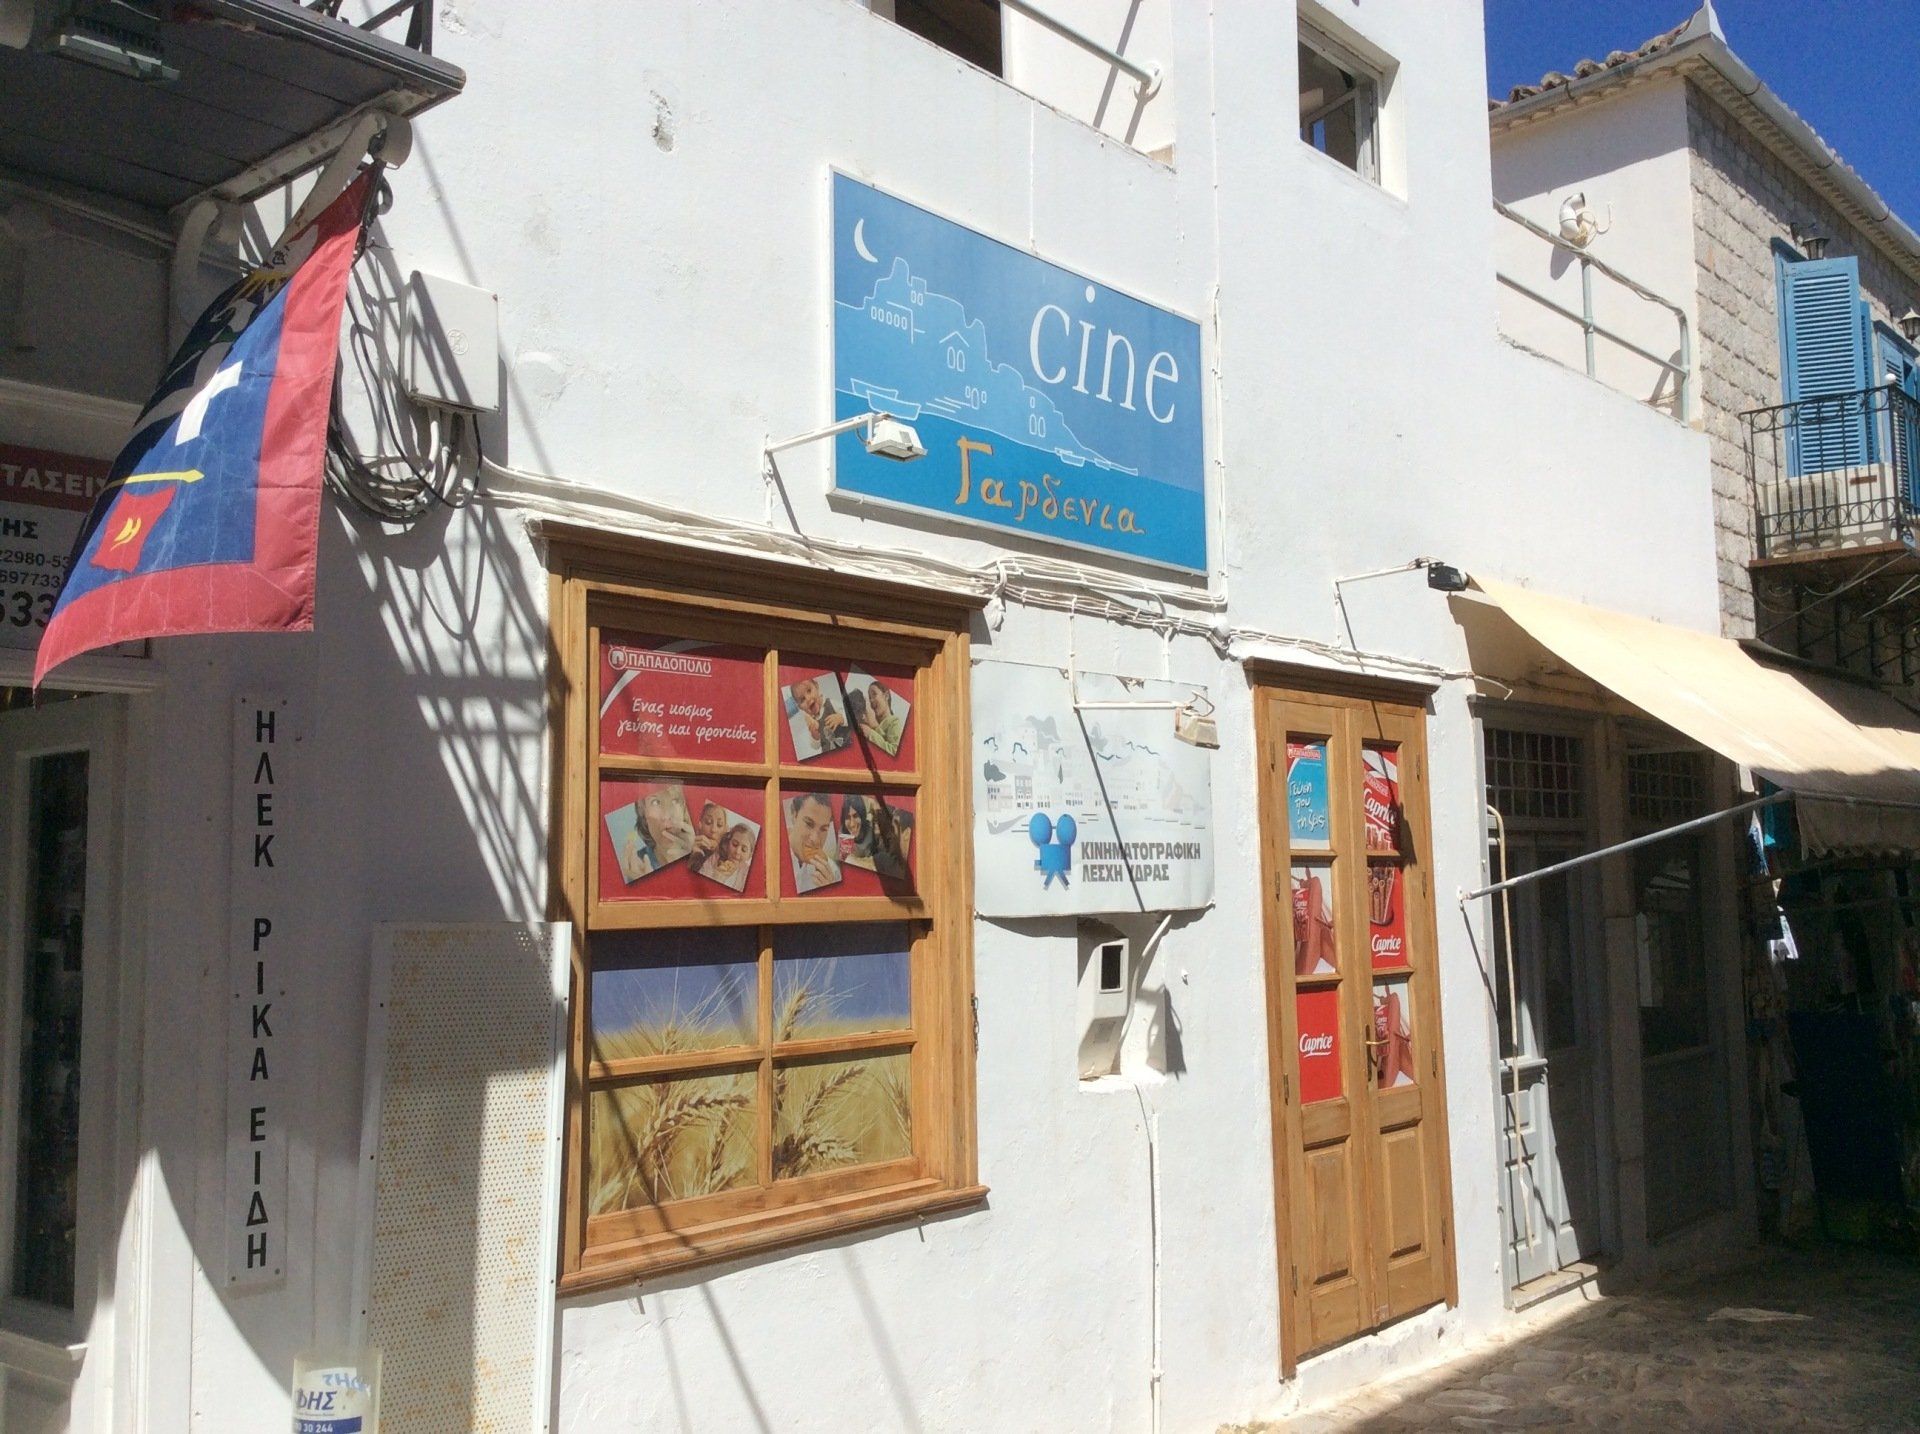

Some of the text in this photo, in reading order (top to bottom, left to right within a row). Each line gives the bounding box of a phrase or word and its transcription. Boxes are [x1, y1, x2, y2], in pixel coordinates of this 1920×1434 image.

[632, 697, 713, 720] Ένας κόσμος
[617, 719, 757, 743] γεύσης και φροντίδας
[1082, 864, 1123, 882] ΛΕΣΧΗ
[1371, 934, 1401, 953] Caprice
[1300, 1033, 1333, 1053] Caprice
[246, 1106, 269, 1269] ΕΙΔΗ
